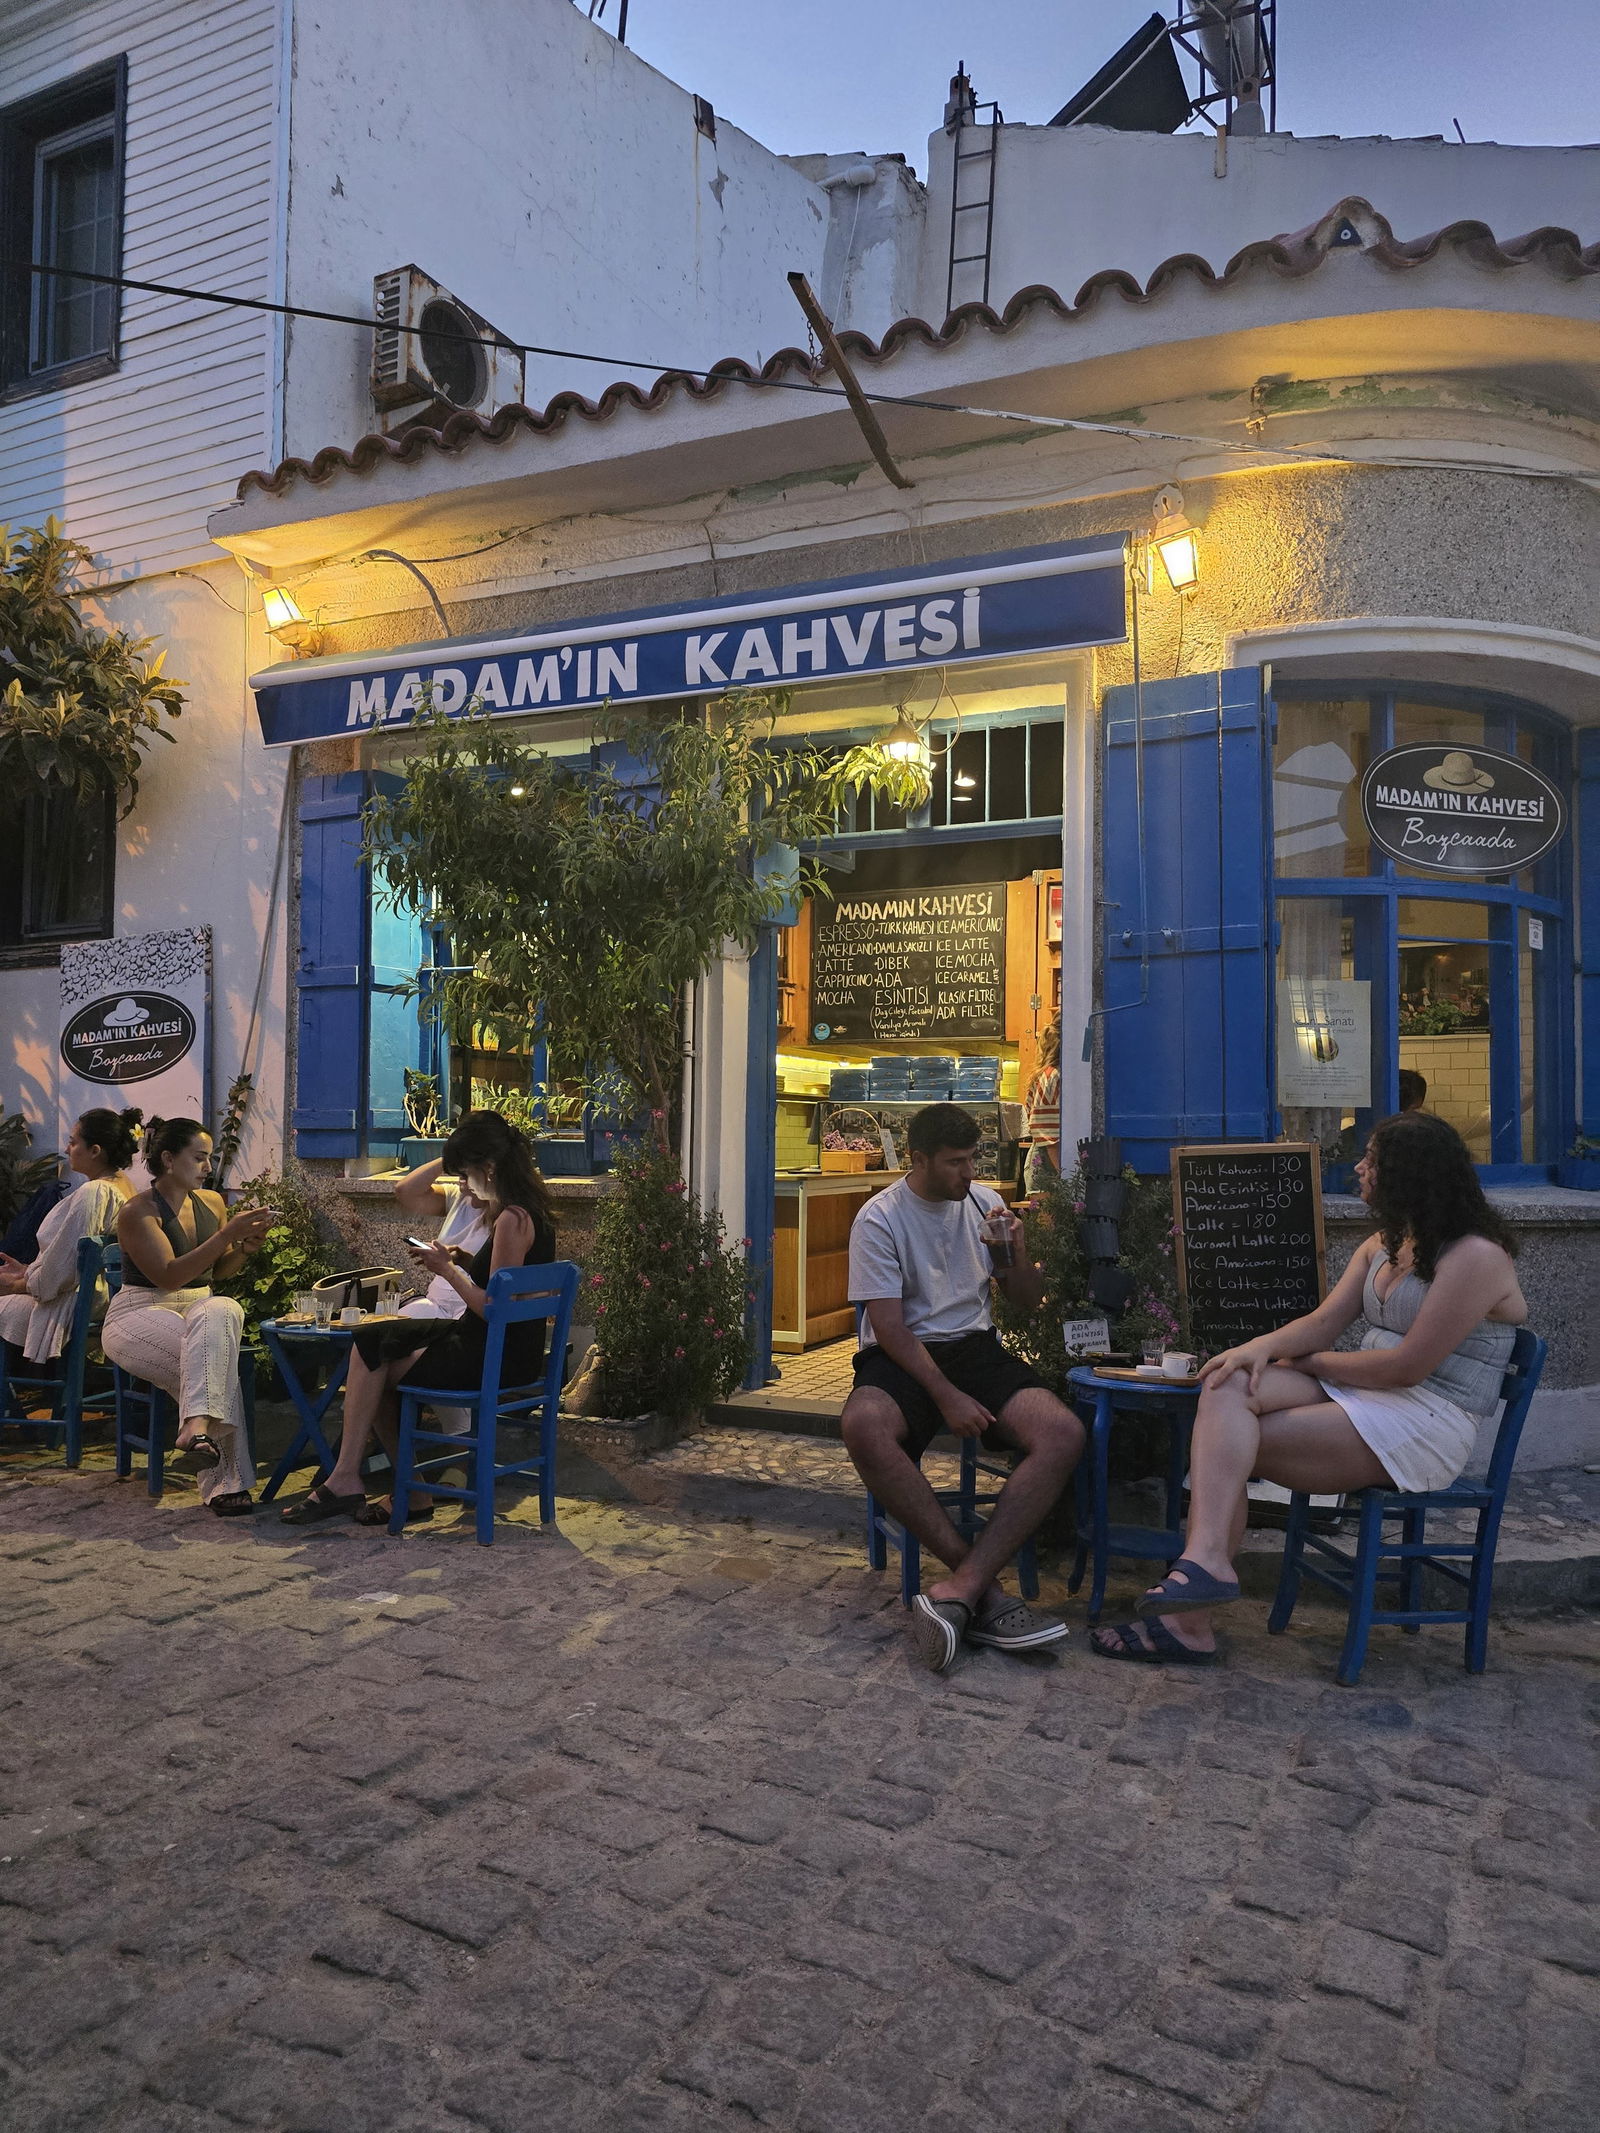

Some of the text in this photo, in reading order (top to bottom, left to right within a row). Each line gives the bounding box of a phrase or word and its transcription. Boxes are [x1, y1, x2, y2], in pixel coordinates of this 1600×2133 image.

[346, 587, 982, 727] MADAM'IN KAHVESİ
[1375, 784, 1545, 817] MADAM'IN KAHVESİ
[1401, 816, 1517, 861] Bozcaada
[918, 891, 993, 917] KAHVESİ
[819, 922, 876, 942] ESPRESSO
[936, 917, 1002, 934] ICE AMERICANO
[819, 942, 874, 957] AMERICANO
[875, 941, 903, 954] DAMLA
[936, 937, 990, 952] ICE LATTE
[817, 958, 854, 973] LATTE
[935, 952, 996, 968] ICE MOCHA
[816, 973, 873, 989] CAPPUCCINO
[876, 971, 903, 988] ADA
[935, 970, 992, 984] ICE CARAMEL
[817, 990, 856, 1006] MOCHA
[936, 1006, 957, 1020] ADA
[72, 1017, 182, 1045] MADAM'IN KAHVESİ
[89, 1043, 164, 1077] Bozcaada
[1272, 1156, 1302, 1174] 130
[1184, 1179, 1216, 1194] Ada
[1278, 1177, 1304, 1193] 130
[1185, 1193, 1291, 1212] Americano 150
[1185, 1217, 1225, 1231] Latte
[1246, 1213, 1276, 1229] 180
[1280, 1233, 1311, 1245] 200
[1286, 1256, 1311, 1269] 150
[1218, 1275, 1261, 1289] Latte
[1272, 1278, 1306, 1289] 200
[1071, 1323, 1089, 1332] ADA
